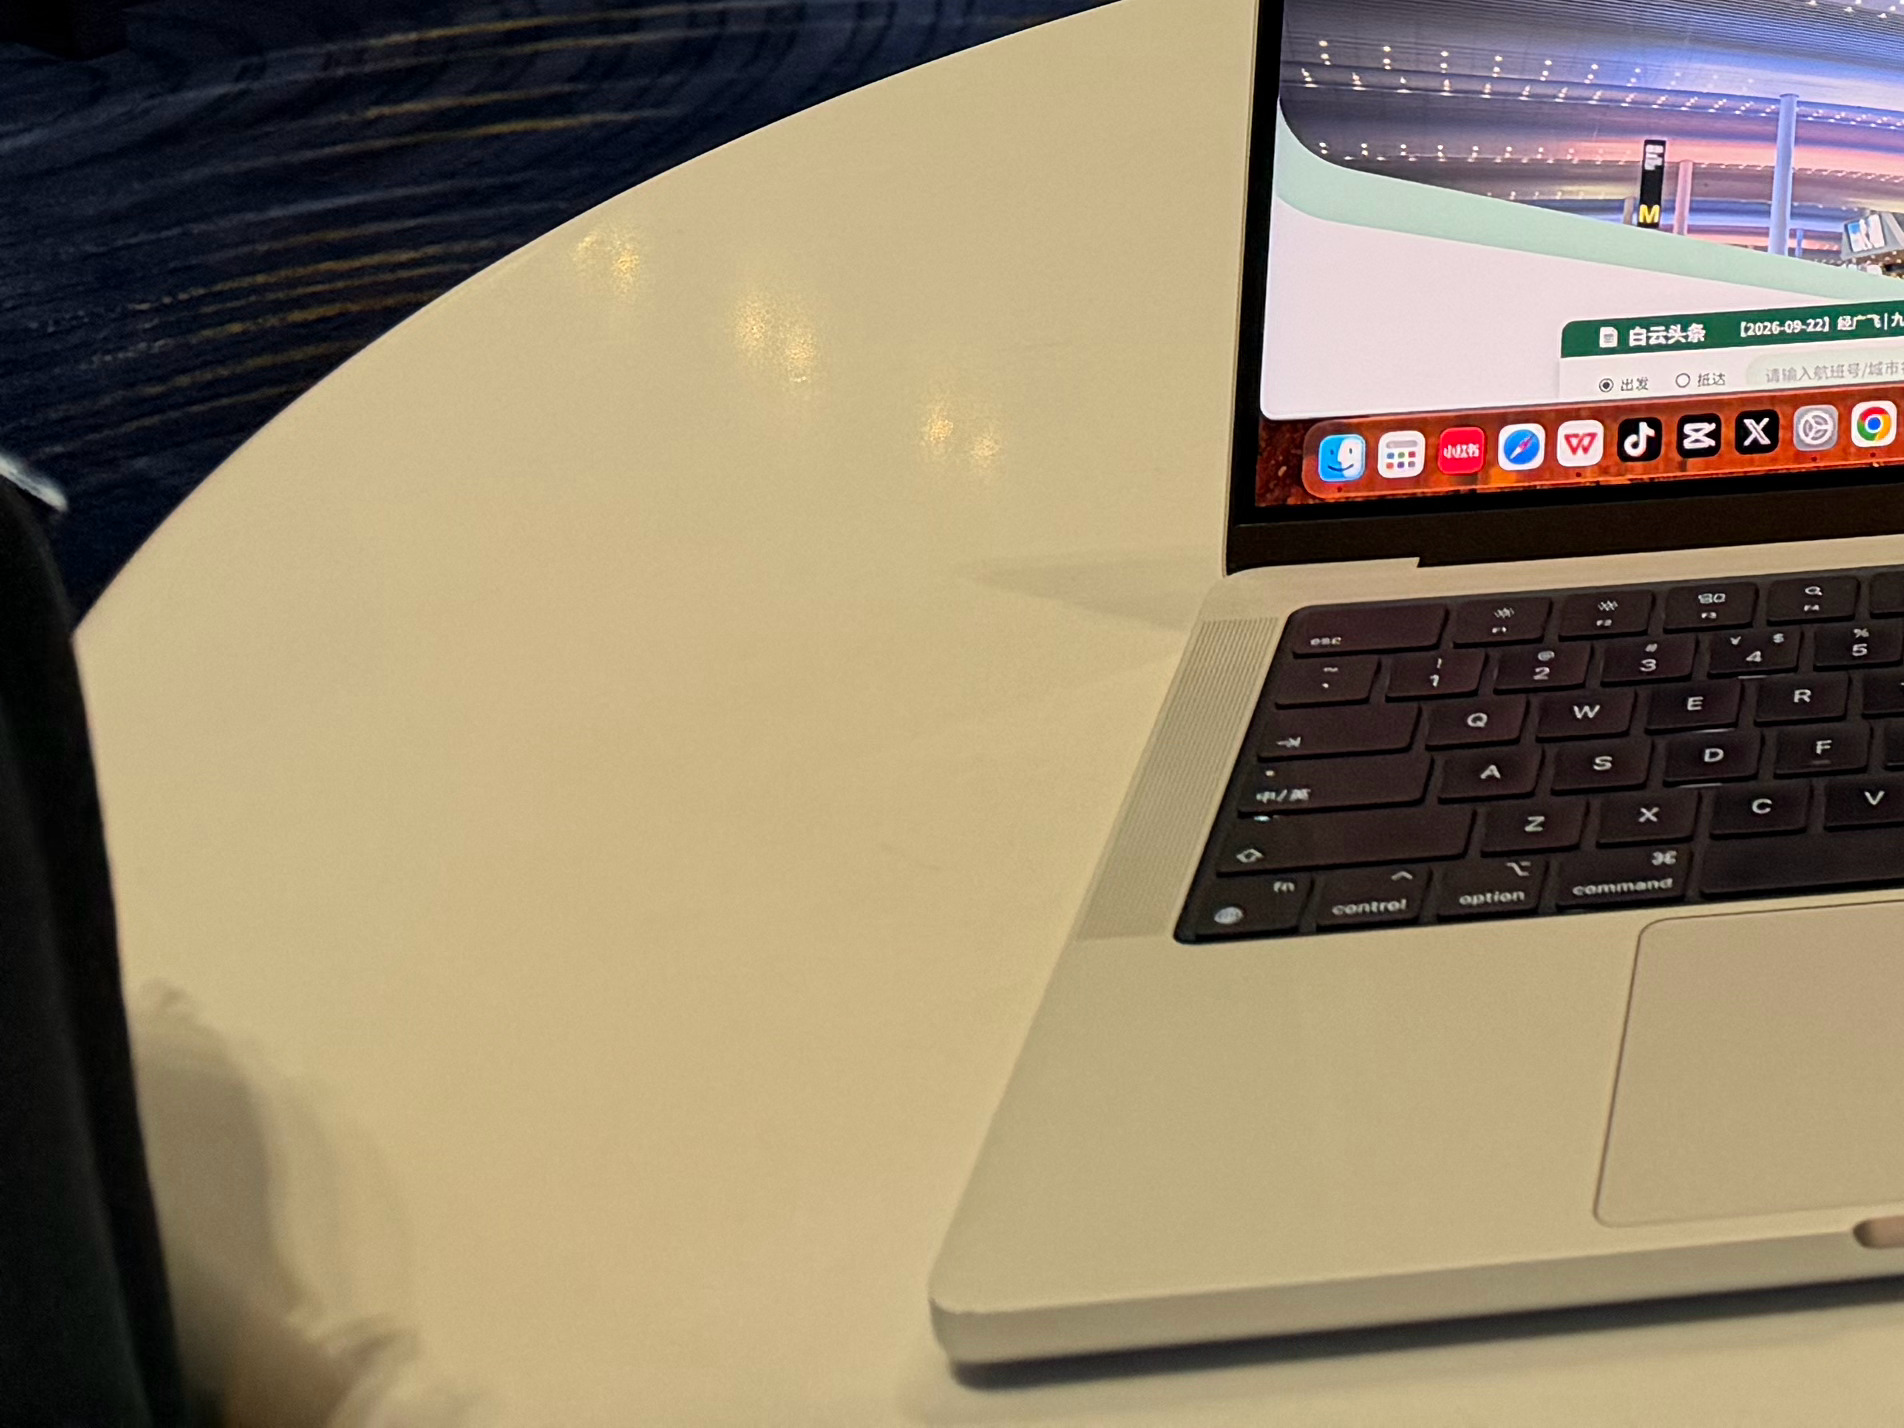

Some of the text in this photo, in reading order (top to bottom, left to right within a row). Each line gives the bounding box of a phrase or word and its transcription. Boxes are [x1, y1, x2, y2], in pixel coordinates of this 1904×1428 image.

[1639, 204, 1661, 223] M
[1629, 323, 1706, 345] 白云头条
[1621, 377, 1649, 392] 出发
[1697, 372, 1726, 387] 抵达
[1745, 650, 1763, 663] 4
[1851, 643, 1869, 656] 5
[1639, 658, 1658, 672] 3
[1430, 674, 1440, 687] 1
[1532, 666, 1551, 681] 2
[1686, 695, 1705, 711] E
[1793, 688, 1812, 703] R
[1466, 711, 1488, 728] Q
[1573, 703, 1600, 720] W
[1703, 747, 1725, 763] D
[1815, 739, 1833, 755] F
[1592, 755, 1613, 771] S
[1479, 763, 1501, 780] A
[1751, 798, 1773, 814] C
[1864, 790, 1885, 806] V
[1637, 806, 1661, 823] X
[1524, 815, 1546, 832] Z
[1572, 877, 1674, 896] command
[1458, 888, 1526, 908] option
[1332, 897, 1407, 916] control
